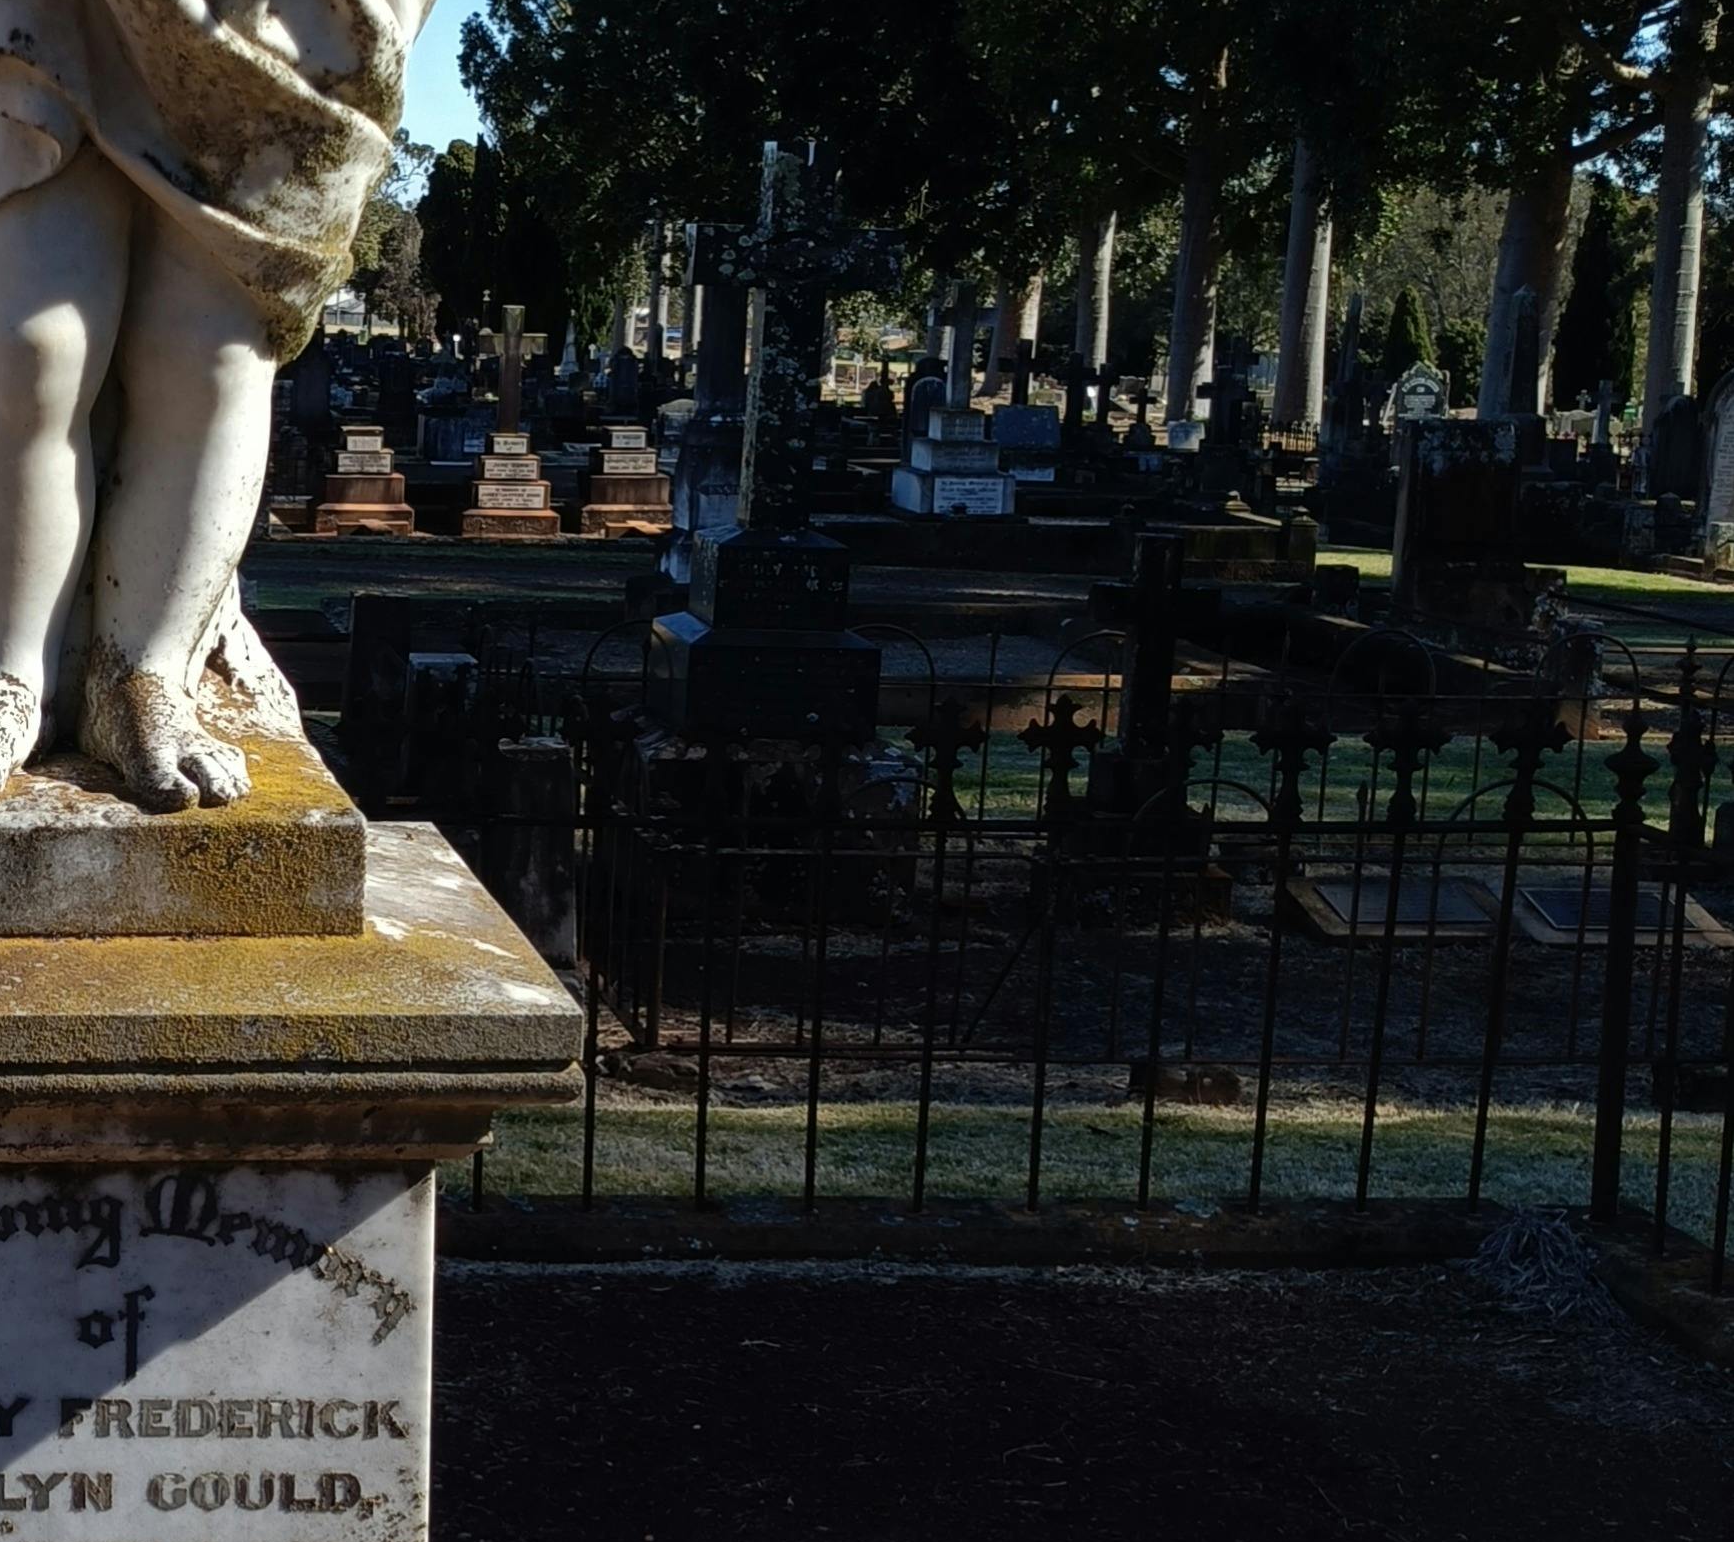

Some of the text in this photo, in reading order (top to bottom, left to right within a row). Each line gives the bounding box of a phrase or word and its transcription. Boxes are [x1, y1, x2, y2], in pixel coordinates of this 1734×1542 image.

[138, 1173, 416, 1347] Memory
[76, 1285, 156, 1385] of
[59, 1396, 407, 1442] FREDERICK
